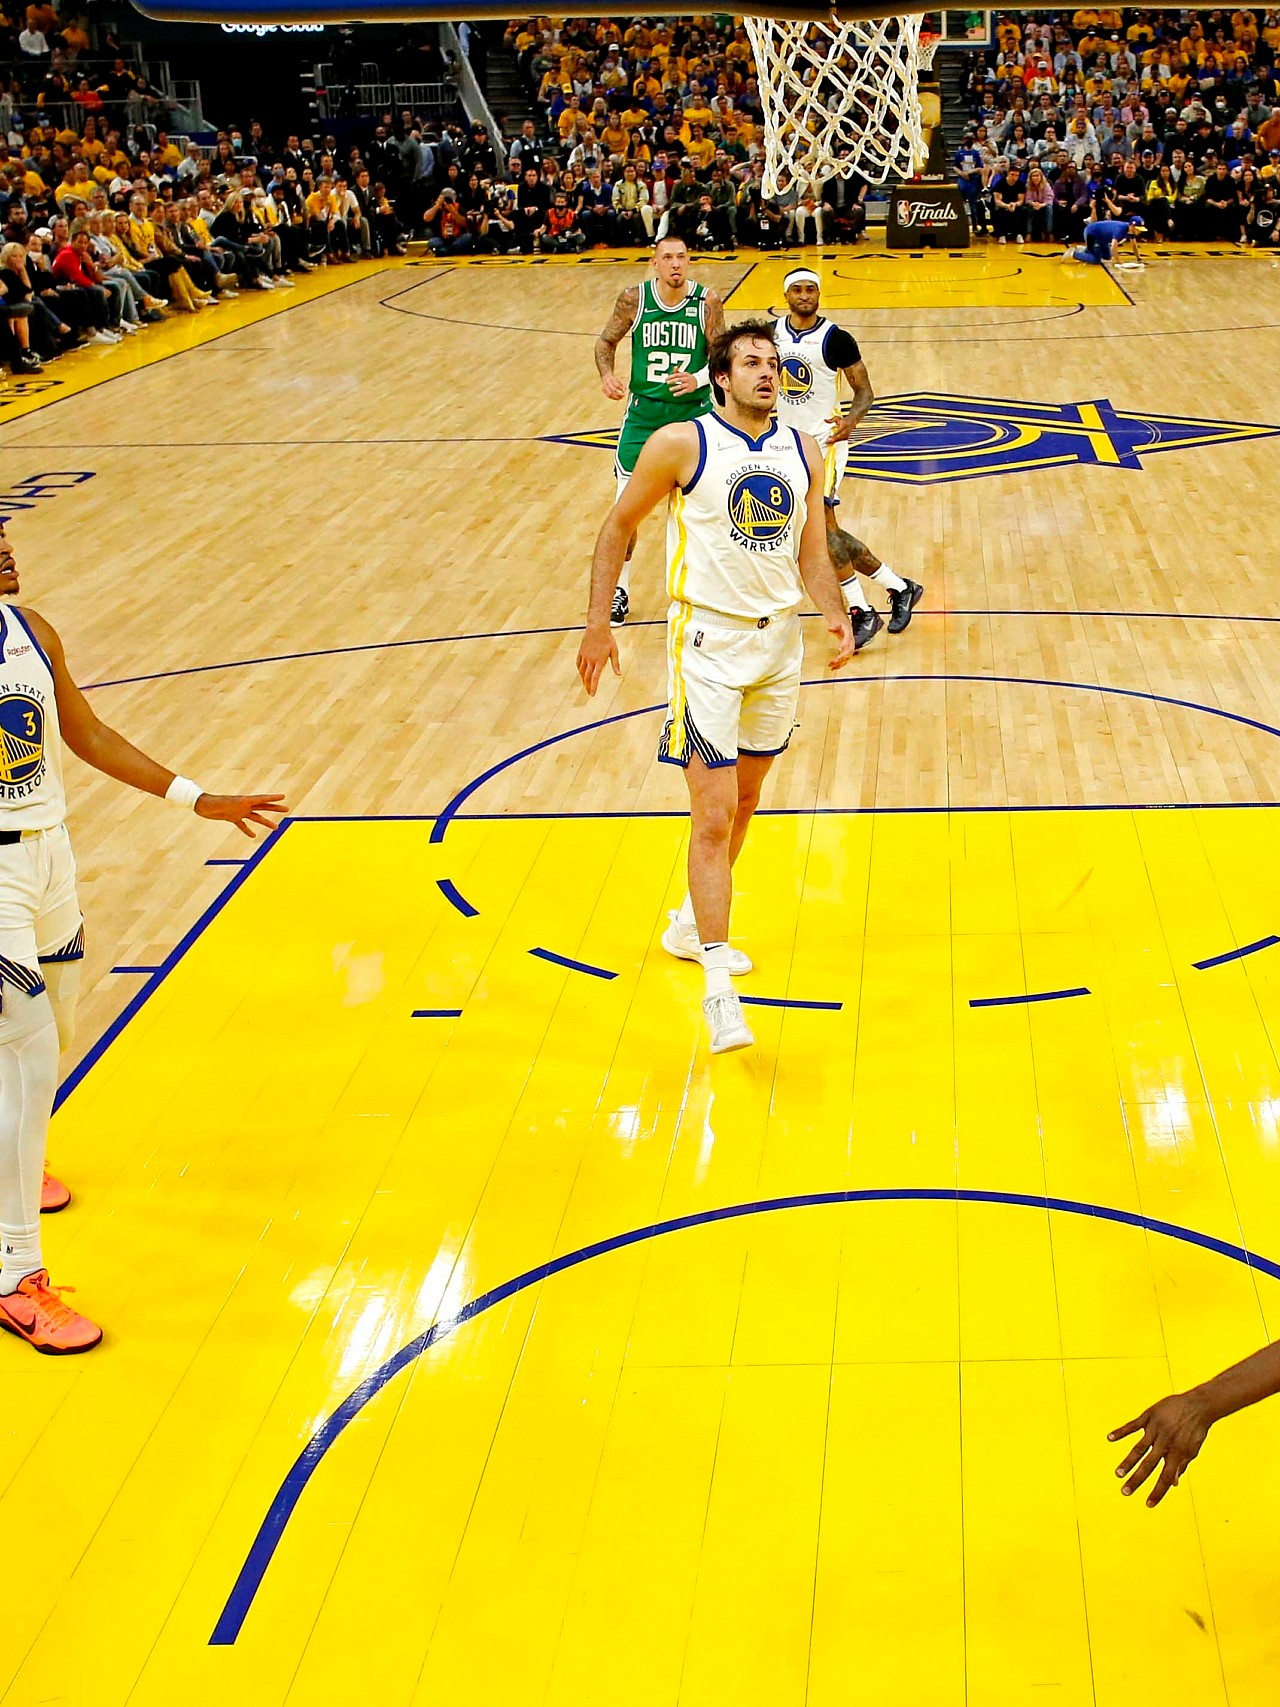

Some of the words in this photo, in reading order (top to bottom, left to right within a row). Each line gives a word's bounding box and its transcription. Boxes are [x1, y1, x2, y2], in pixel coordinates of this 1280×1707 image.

[903, 201, 958, 228] Finals
[642, 321, 698, 350] BOSTON
[646, 351, 692, 384] 27
[725, 463, 762, 486] GOLDEN
[769, 486, 783, 506] 8
[15, 683, 47, 704] STATE
[22, 711, 37, 737] 3
